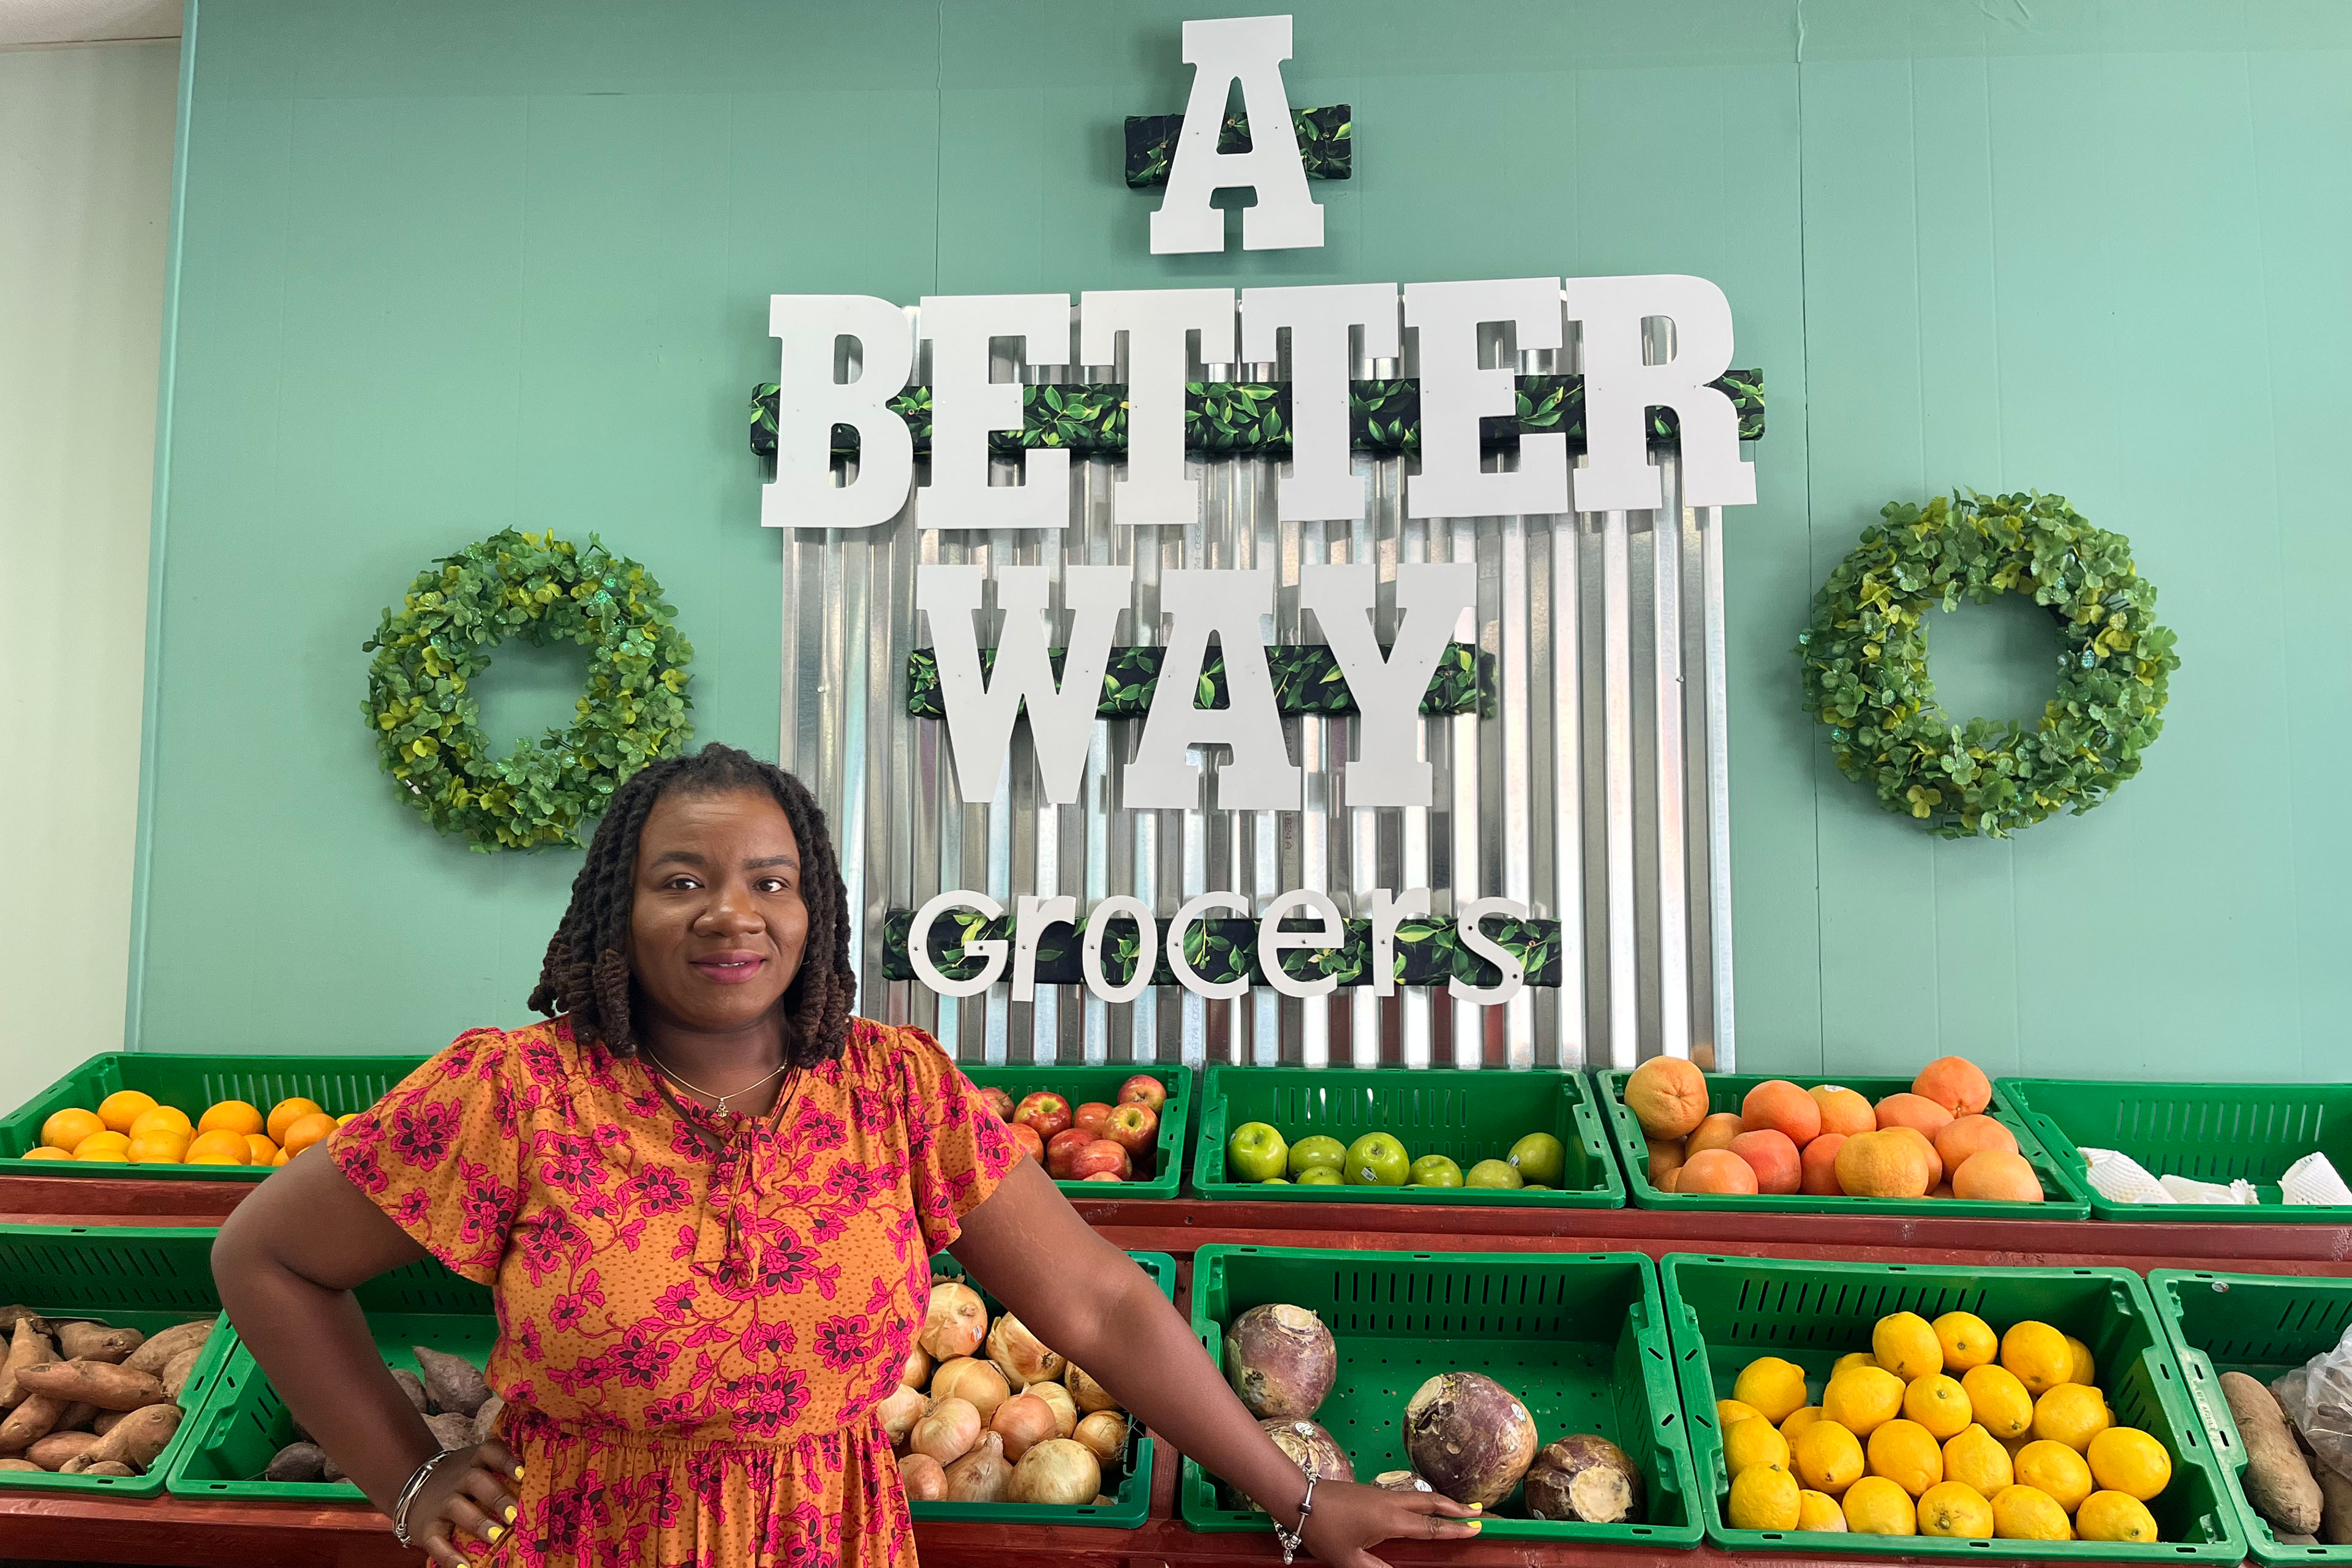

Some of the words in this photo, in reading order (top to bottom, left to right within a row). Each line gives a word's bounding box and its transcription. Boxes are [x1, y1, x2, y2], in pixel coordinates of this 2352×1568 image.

[1150, 14, 1325, 254] A
[761, 273, 1758, 529] BETTER
[916, 562, 1477, 811] WAY
[907, 887, 1528, 1006] Grocers
